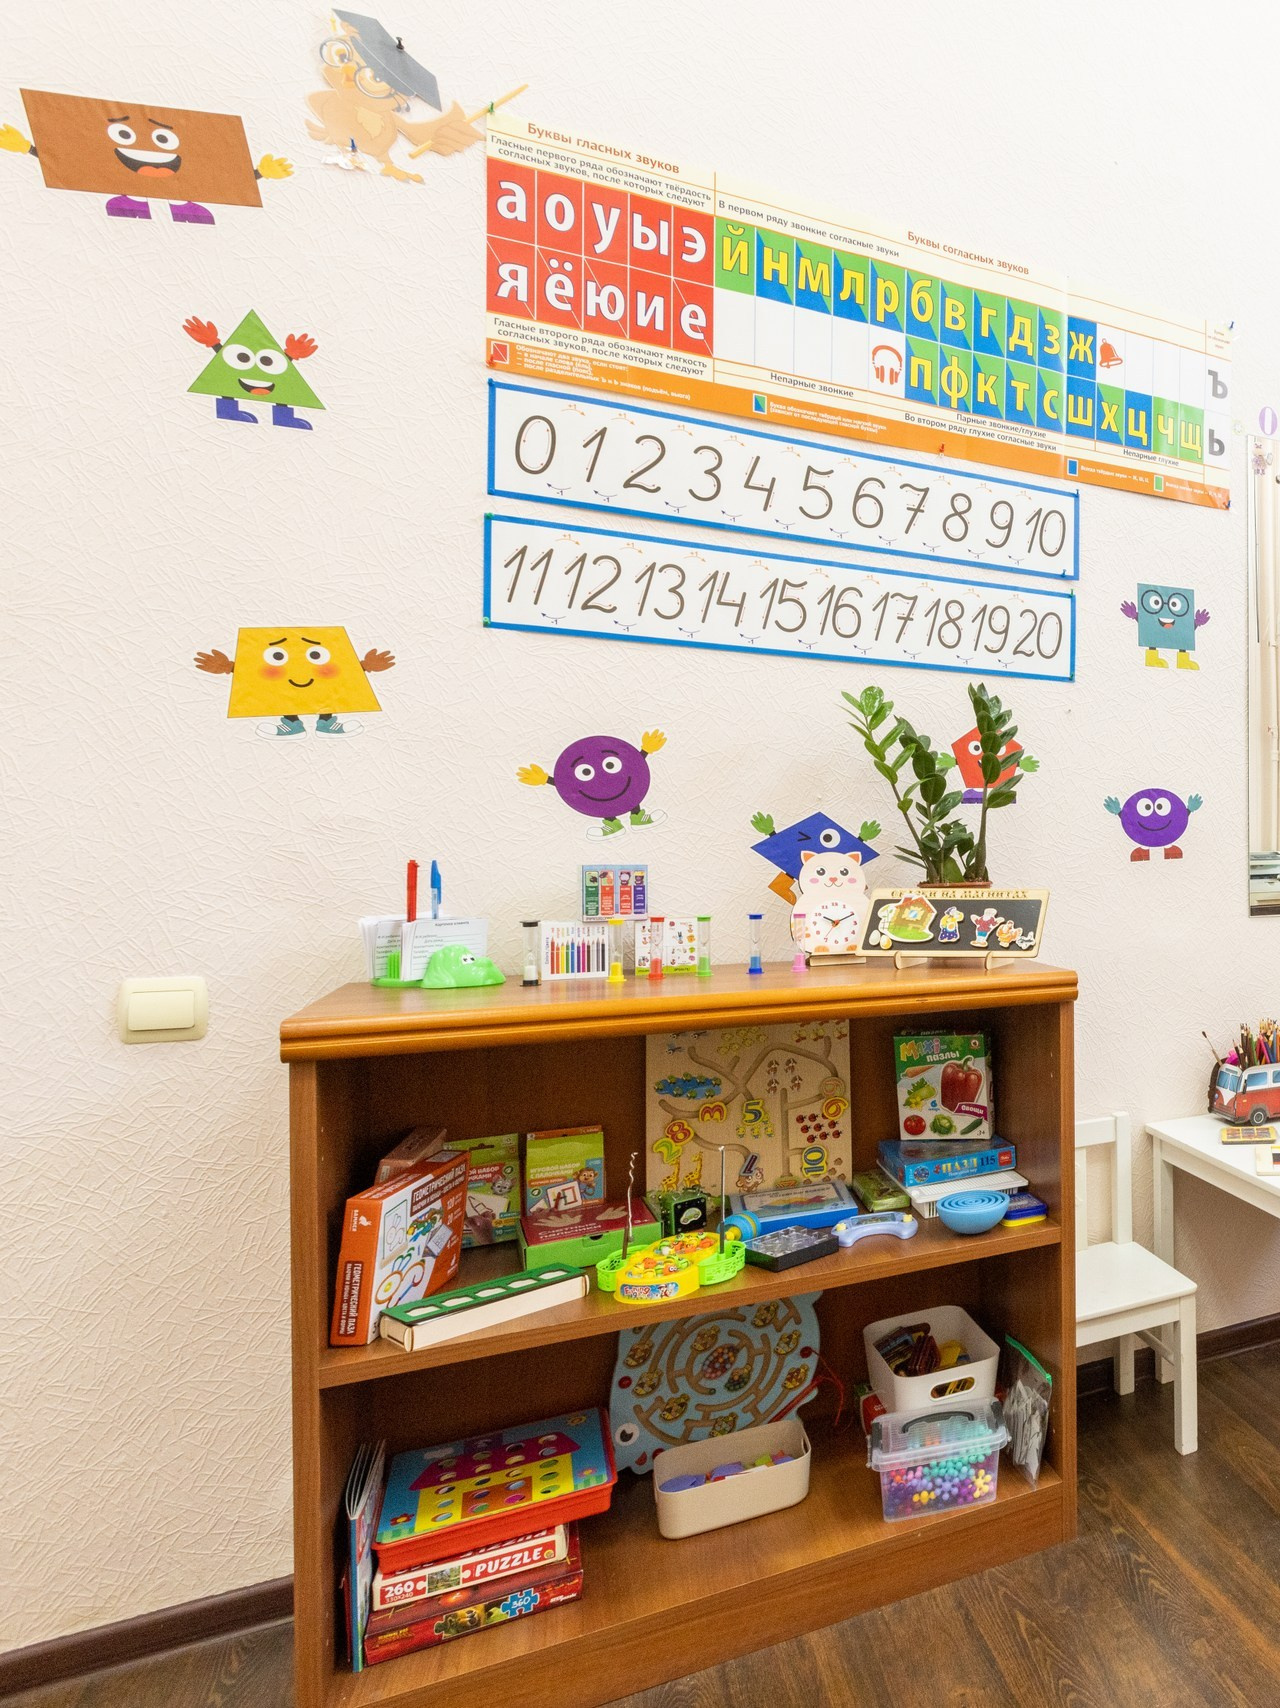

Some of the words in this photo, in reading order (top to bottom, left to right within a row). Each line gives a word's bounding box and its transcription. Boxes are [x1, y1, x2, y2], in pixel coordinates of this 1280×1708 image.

[528, 122, 572, 144] Буквы
[577, 138, 631, 160] гласных
[636, 153, 679, 174] звуков
[491, 135, 533, 153] Гласные
[537, 148, 576, 165] первого
[580, 159, 603, 172] ряда
[606, 165, 662, 188] обозначают
[665, 181, 711, 201] твёрдость
[498, 148, 551, 168] согласных
[554, 162, 590, 178] звуков,
[593, 171, 621, 185] после
[624, 178, 663, 197] которых
[667, 191, 705, 208] следуют
[496, 181, 527, 223] а
[545, 193, 575, 232] о
[592, 202, 621, 254] у
[632, 213, 669, 256] ы
[681, 226, 707, 263] э
[719, 200, 725, 208] В
[728, 204, 764, 219] первом
[766, 214, 788, 227] ряду
[791, 222, 827, 237] звонкие
[829, 232, 873, 249] согласные
[876, 244, 899, 257] звуки
[908, 231, 939, 249] Буквы
[943, 245, 994, 265] согласных
[997, 260, 1029, 275] звуков
[497, 263, 528, 303] я
[545, 258, 574, 311] ё
[586, 280, 626, 322] ю
[636, 291, 665, 331] и
[680, 304, 707, 340] е
[722, 224, 750, 276] й
[763, 247, 789, 286] н
[797, 257, 831, 297] м
[839, 269, 865, 306] л
[876, 277, 900, 323] р
[910, 279, 934, 323] б
[944, 297, 967, 331] в
[980, 306, 998, 338] г
[1008, 315, 1034, 357] д
[1043, 324, 1061, 355] з
[1068, 331, 1095, 365] ж
[494, 318, 536, 333] Гласные
[539, 328, 578, 342] второго
[582, 336, 605, 348] ряда
[608, 341, 663, 359] обозначают
[667, 354, 707, 369] мягкость
[498, 328, 550, 346] согласных
[554, 340, 589, 354] звуков,
[592, 348, 620, 359] после
[623, 353, 662, 368] которых
[666, 363, 704, 376] следуют
[516, 344, 556, 357] Обозначают
[770, 373, 816, 390] Непарные
[818, 384, 854, 397] звонкие
[909, 355, 933, 392] п
[940, 355, 969, 409] ф
[976, 372, 999, 406] к
[1010, 379, 1031, 411] т
[1042, 390, 1059, 420] с
[1067, 393, 1093, 427] ш
[1100, 401, 1120, 433] х
[1127, 408, 1148, 447] ц
[1157, 414, 1175, 446] ч
[1180, 420, 1203, 460] щ
[956, 414, 986, 426] Парные
[989, 421, 1046, 439] звонкие/глухие
[1259, 406, 1278, 436] 0
[905, 413, 915, 422] Во
[917, 417, 946, 429] втором
[949, 424, 967, 435] ряду
[969, 428, 995, 439] глухие
[997, 433, 1034, 447] согласные
[1037, 441, 1057, 452] звуки
[1123, 449, 1156, 462] Непарные
[1158, 455, 1179, 467] глухие
[515, 415, 557, 475] 0
[582, 426, 608, 483] 1
[622, 434, 666, 494] 2
[688, 445, 723, 502] 3
[743, 455, 776, 512] 4
[798, 465, 835, 520] 5
[852, 477, 886, 529] 6
[899, 483, 930, 535] 7
[942, 492, 973, 543] 8
[985, 500, 1014, 549] 9
[1025, 507, 1067, 558] 10
[503, 545, 555, 606] 11
[564, 552, 622, 614] 12
[634, 561, 686, 620] 13
[698, 570, 747, 628] 14
[759, 577, 808, 633] 15
[817, 584, 863, 639] 16
[872, 591, 919, 644] 17
[924, 598, 965, 649] 18
[971, 604, 1011, 654] 19
[1012, 608, 1064, 660] 20
[927, 1051, 959, 1062] пазлы
[744, 1101, 762, 1124] 5
[961, 1105, 984, 1114] Овощи
[667, 1121, 692, 1144] 8
[942, 1157, 977, 1174] ПАЗЛ
[980, 1155, 996, 1167] 115
[475, 1547, 543, 1577] PUZZLE
[385, 1580, 414, 1598] 260
[511, 1596, 531, 1608] 360
